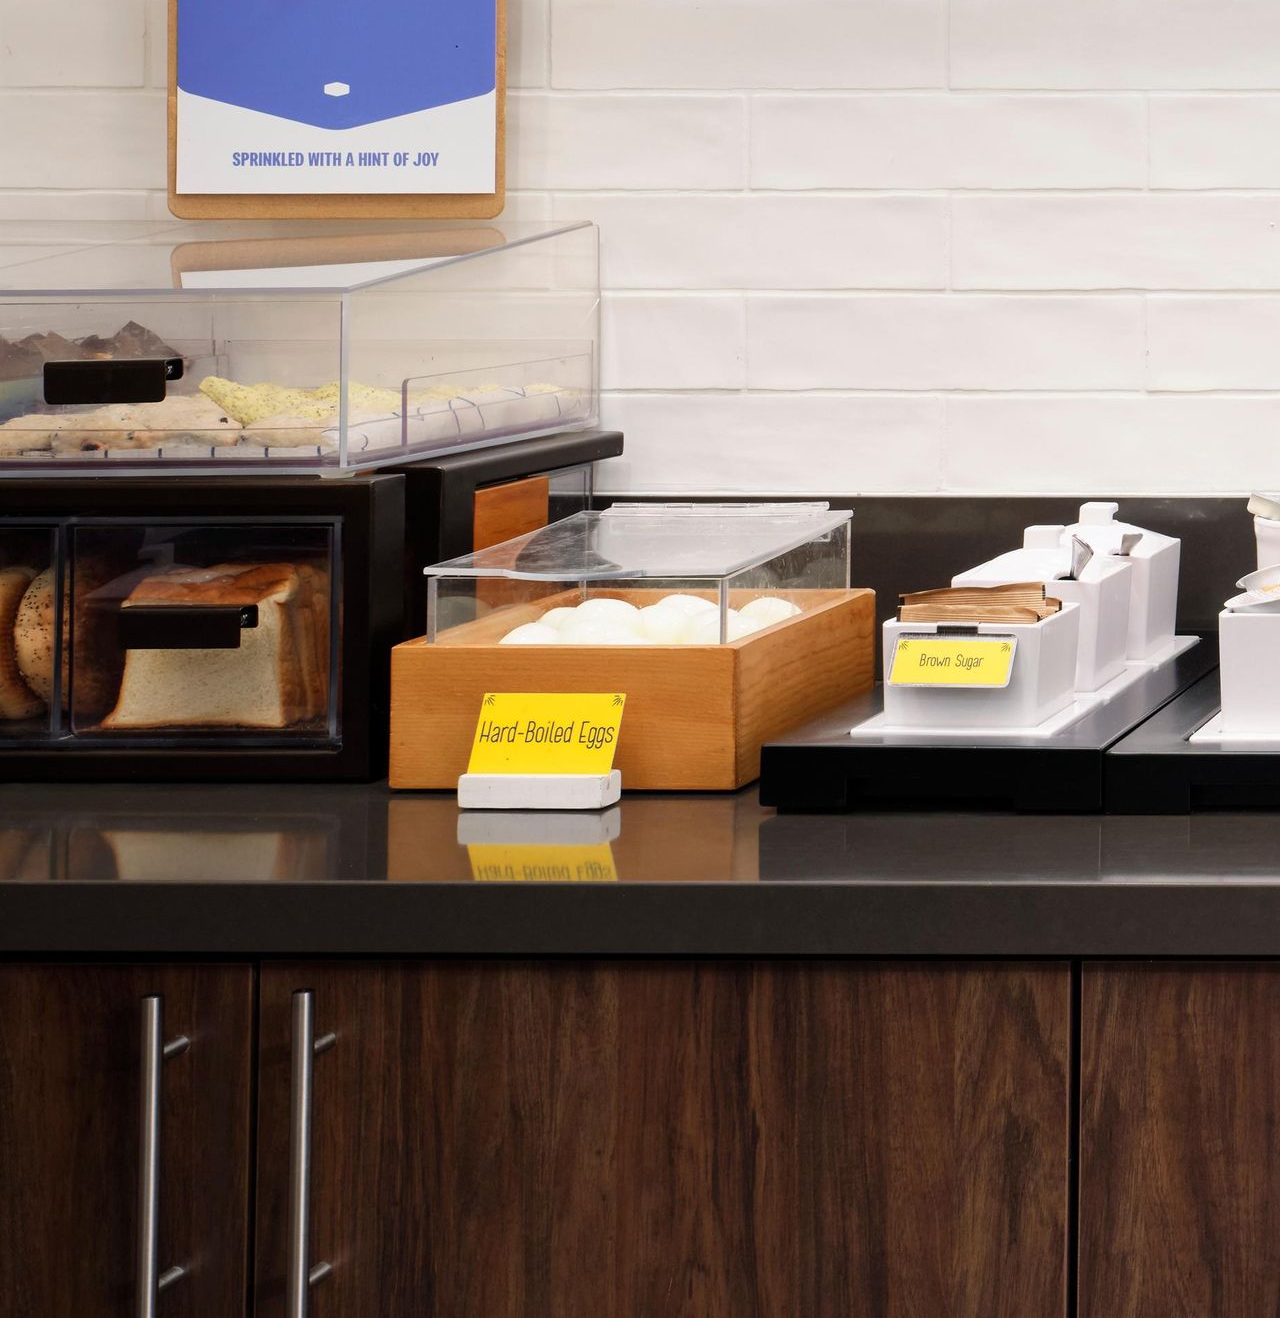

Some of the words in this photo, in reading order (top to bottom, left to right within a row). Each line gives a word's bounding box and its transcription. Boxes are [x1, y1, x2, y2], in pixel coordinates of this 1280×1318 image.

[232, 151, 304, 168] SPRINKLED
[308, 151, 342, 168] WITH
[345, 151, 355, 168] A
[358, 151, 388, 168] HINT
[393, 151, 409, 168] OF
[413, 151, 440, 168] JOY
[919, 653, 951, 667] Brown
[955, 653, 985, 671] Sugar
[479, 720, 575, 743] Hard-Boiled
[578, 720, 616, 749] Eggs
